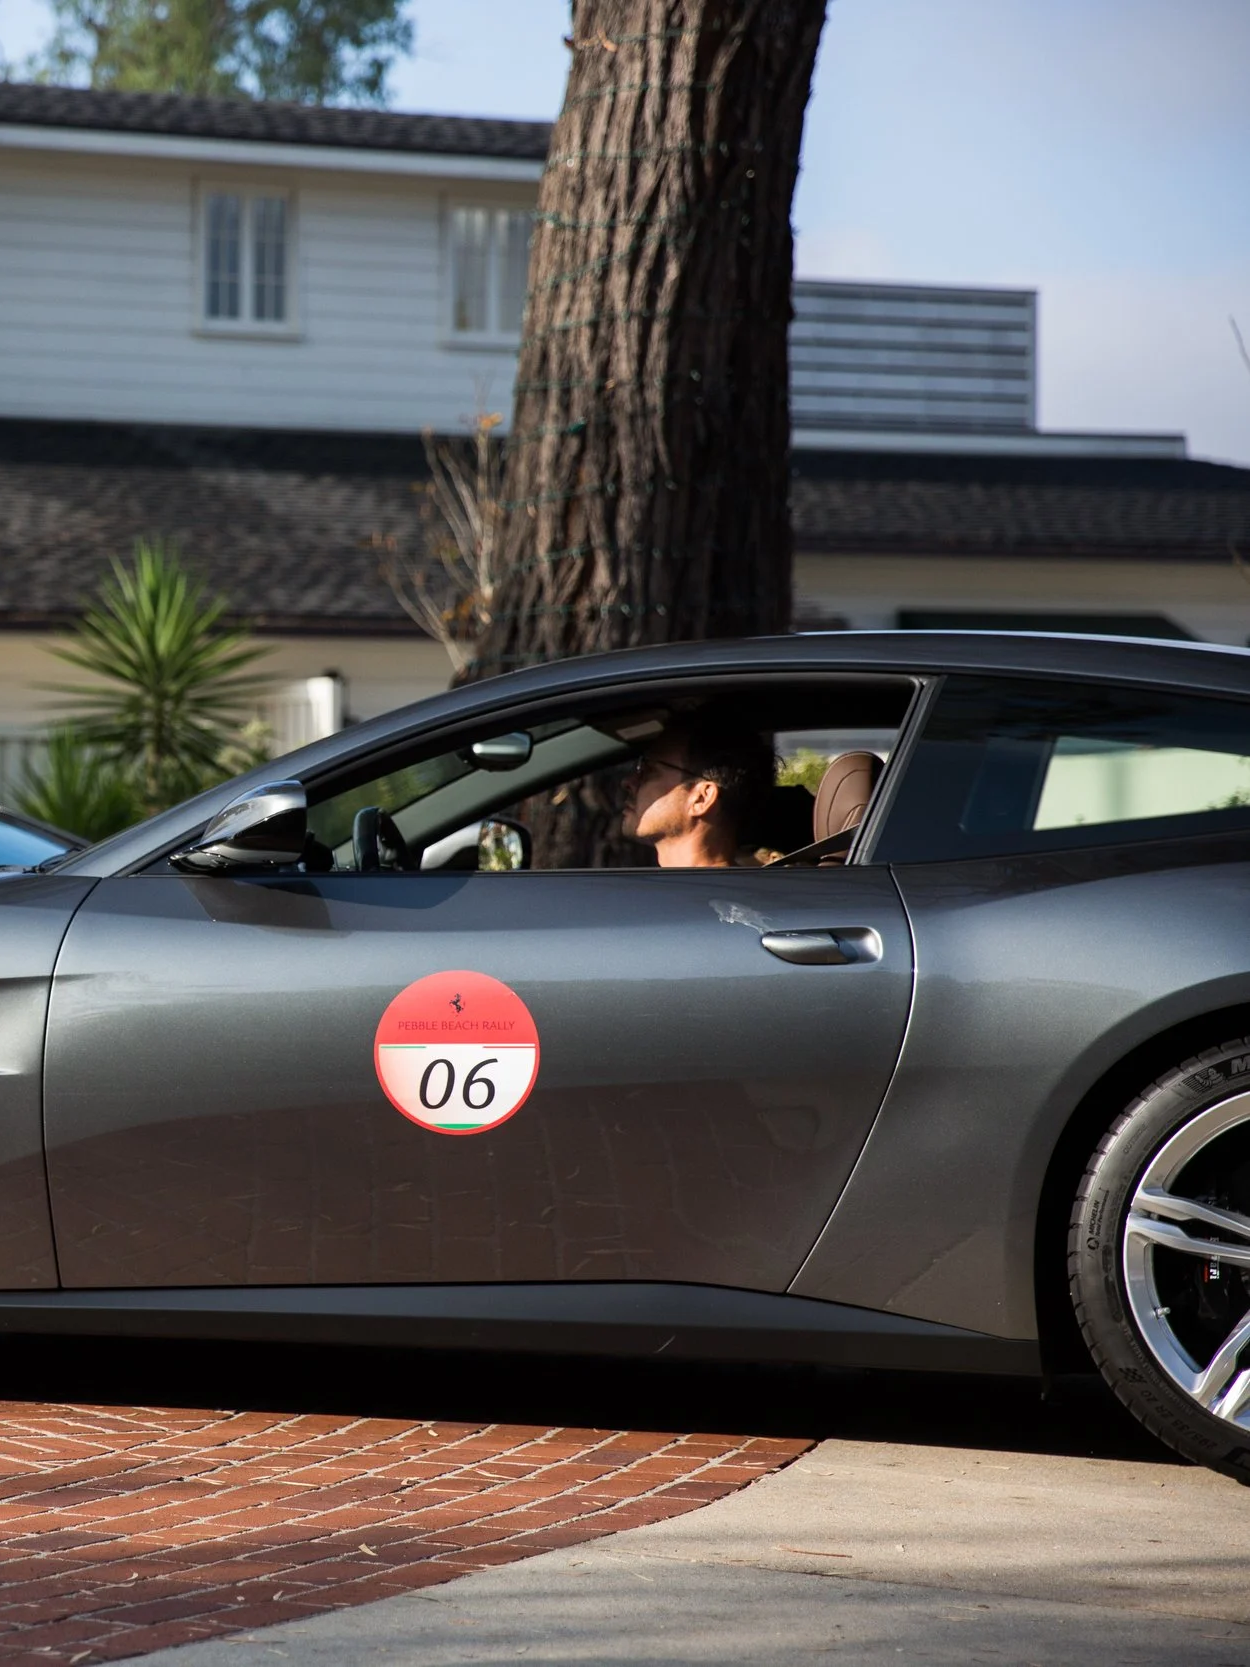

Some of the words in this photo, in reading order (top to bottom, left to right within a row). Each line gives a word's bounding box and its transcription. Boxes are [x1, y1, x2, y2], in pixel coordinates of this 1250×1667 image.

[398, 1021, 438, 1031] PEBBLE
[441, 1021, 479, 1031] BEACH
[483, 1021, 515, 1031] RALLY
[419, 1058, 498, 1110] 06
[1088, 1200, 1100, 1236] MICHELIN
